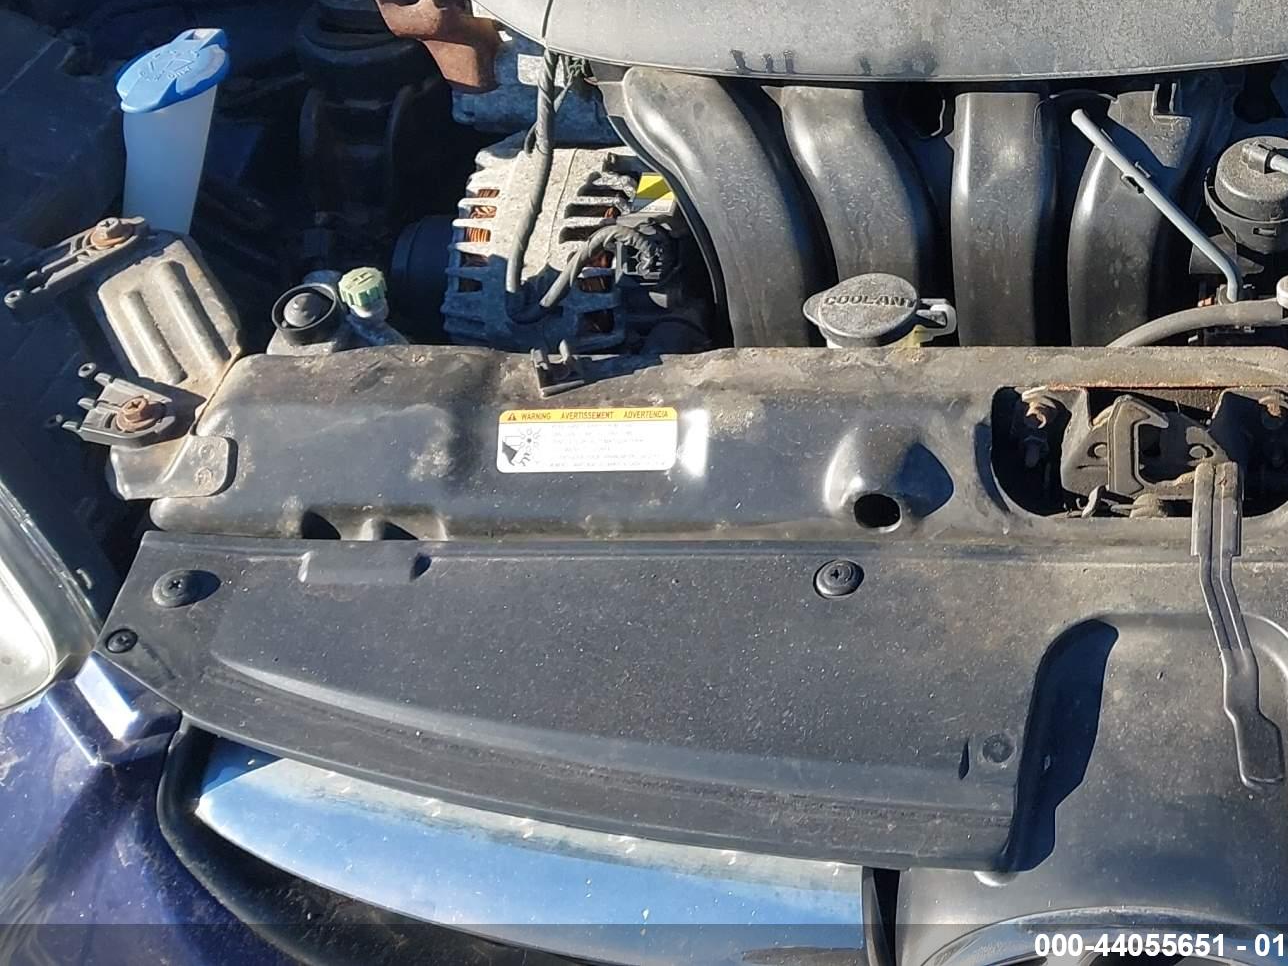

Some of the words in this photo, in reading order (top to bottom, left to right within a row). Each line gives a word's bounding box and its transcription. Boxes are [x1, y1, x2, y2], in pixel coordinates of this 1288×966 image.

[824, 295, 915, 308] COOLANT
[521, 412, 551, 420] WARNING
[560, 411, 615, 420] AVERTISSEMENT
[624, 411, 669, 419] ADVERTENCIA
